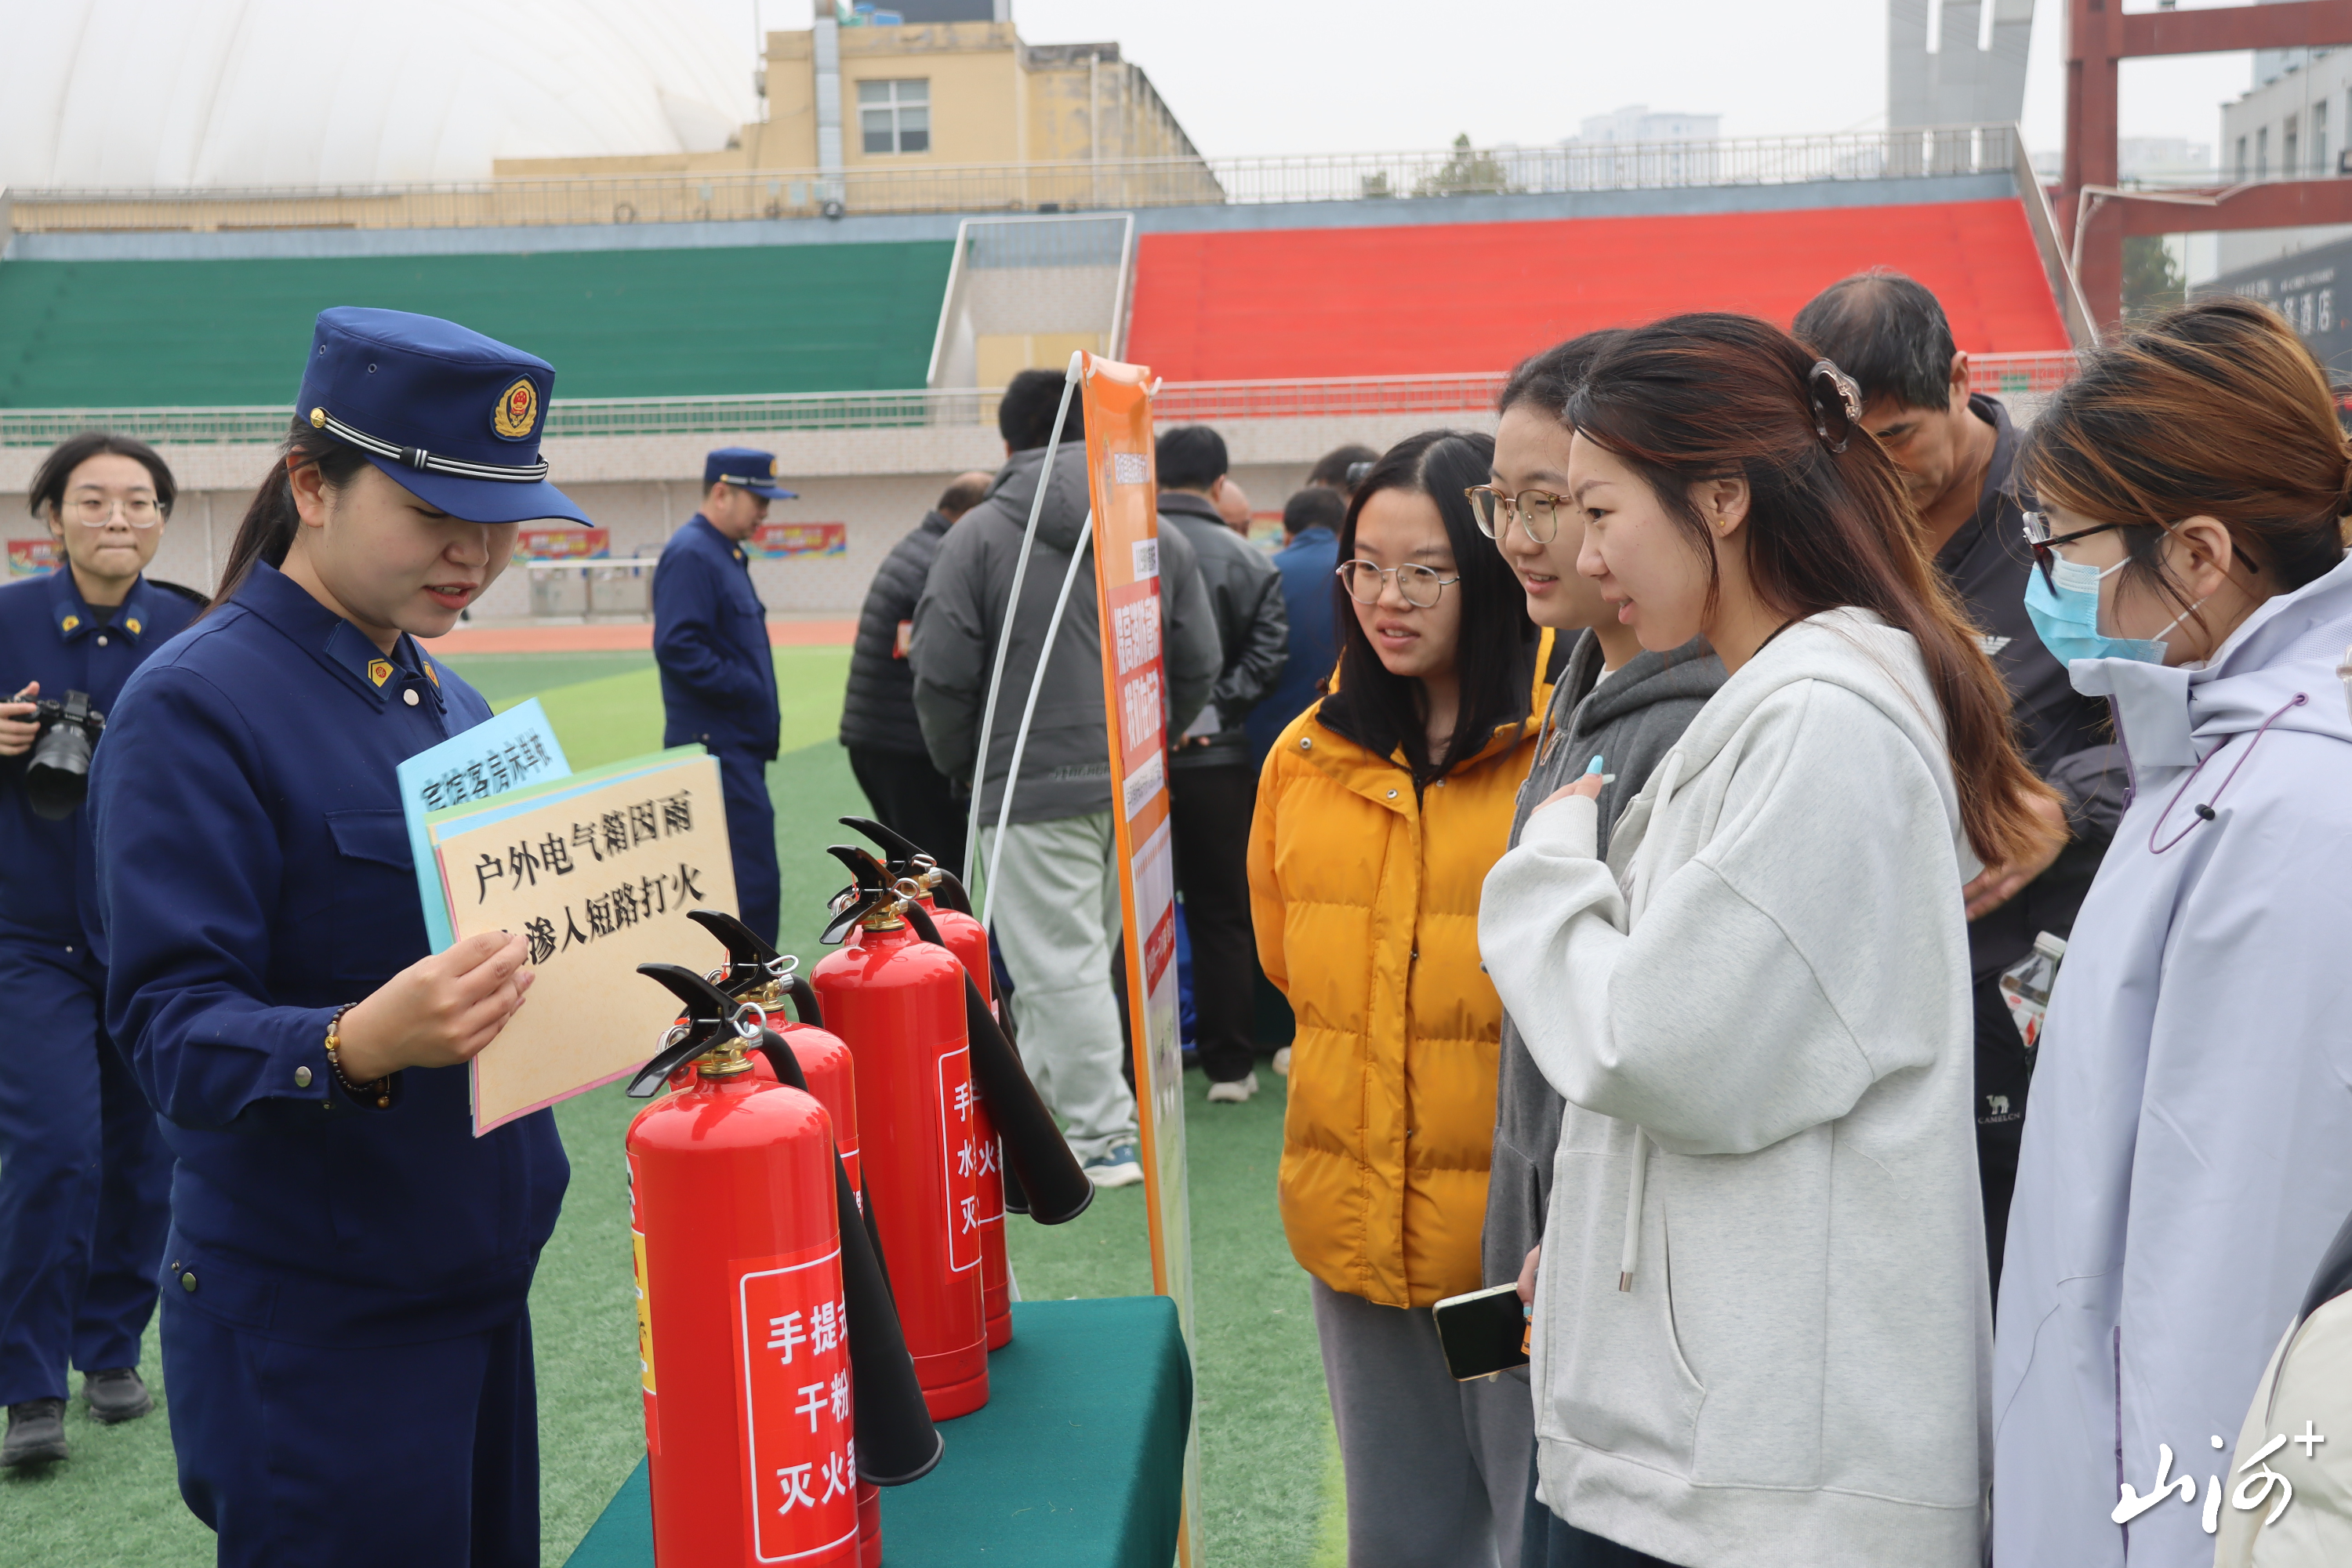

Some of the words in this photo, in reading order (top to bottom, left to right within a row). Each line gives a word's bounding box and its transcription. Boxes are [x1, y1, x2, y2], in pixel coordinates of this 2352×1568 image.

[475, 789, 695, 905] 户外电气箱因雨
[502, 862, 706, 965] 渗人短路打火
[795, 1367, 849, 1433] 干粉
